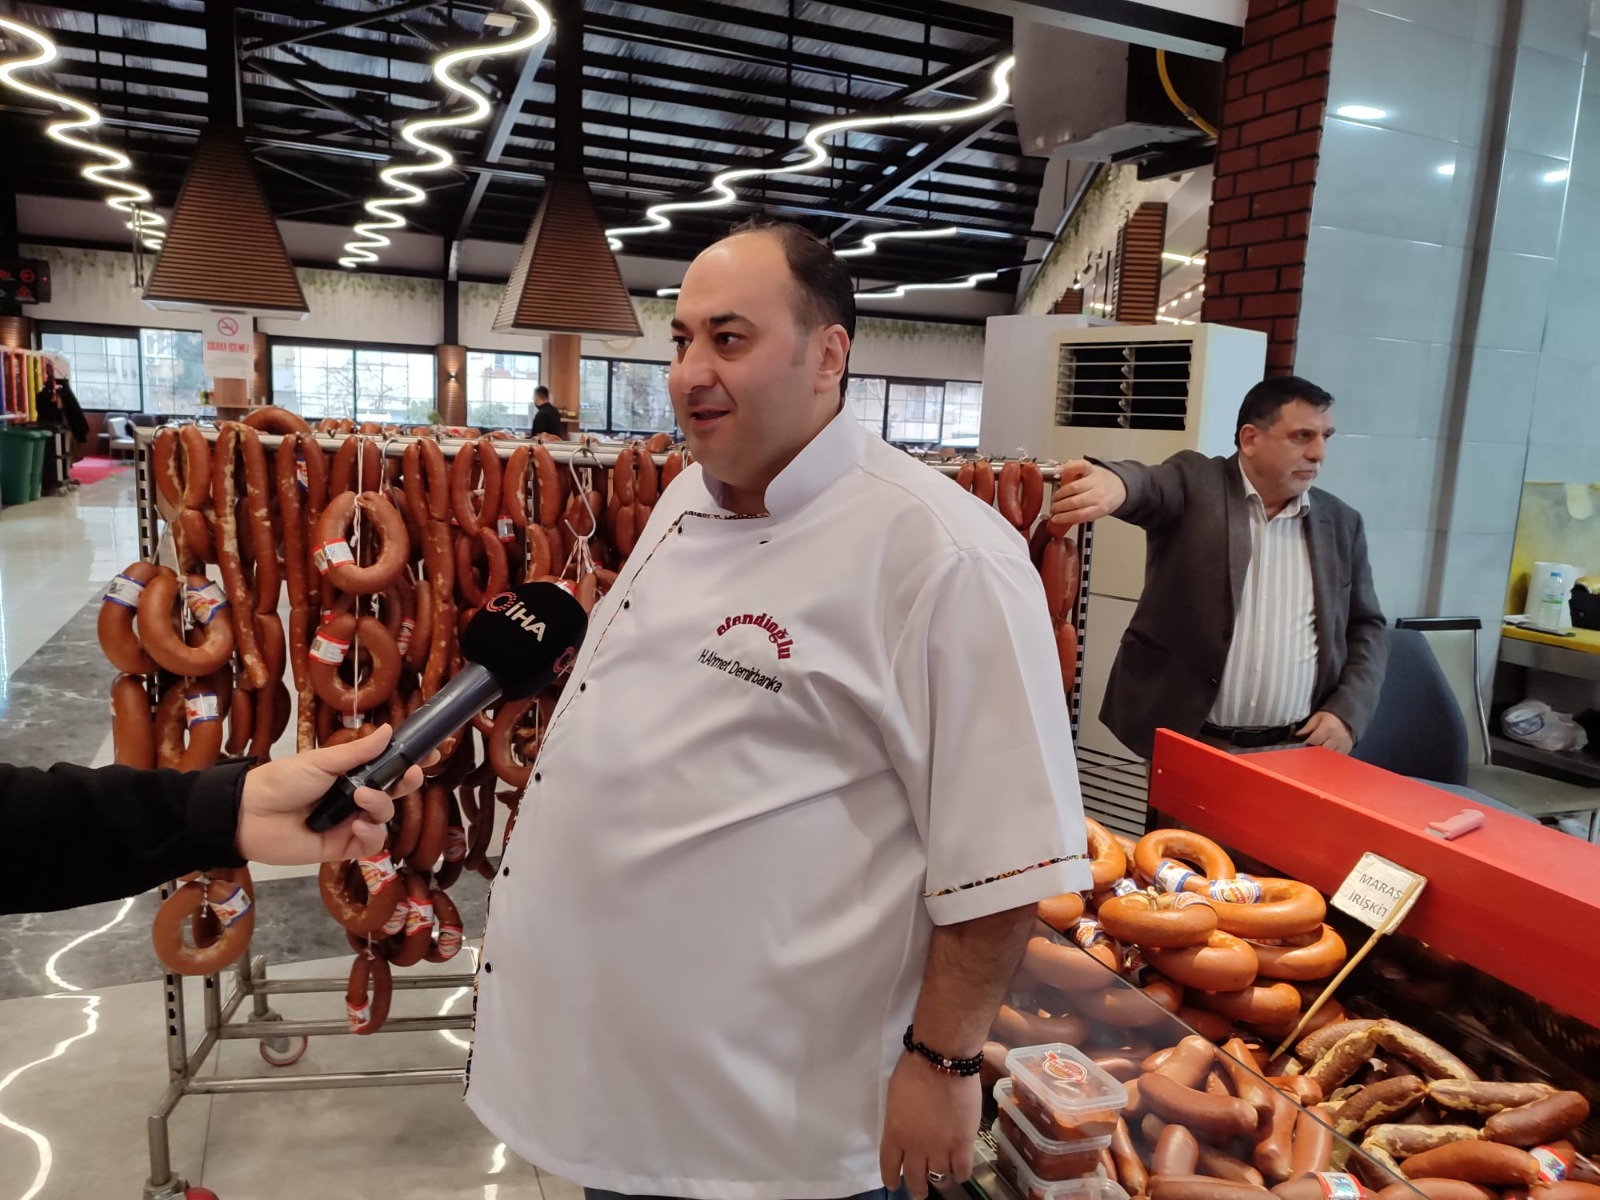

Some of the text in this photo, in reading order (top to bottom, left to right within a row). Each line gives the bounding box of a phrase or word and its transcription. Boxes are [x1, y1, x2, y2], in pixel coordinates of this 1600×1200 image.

[505, 601, 546, 642] İHA
[716, 612, 794, 660] efendioğlu
[1358, 873, 1404, 901] MARAŞ
